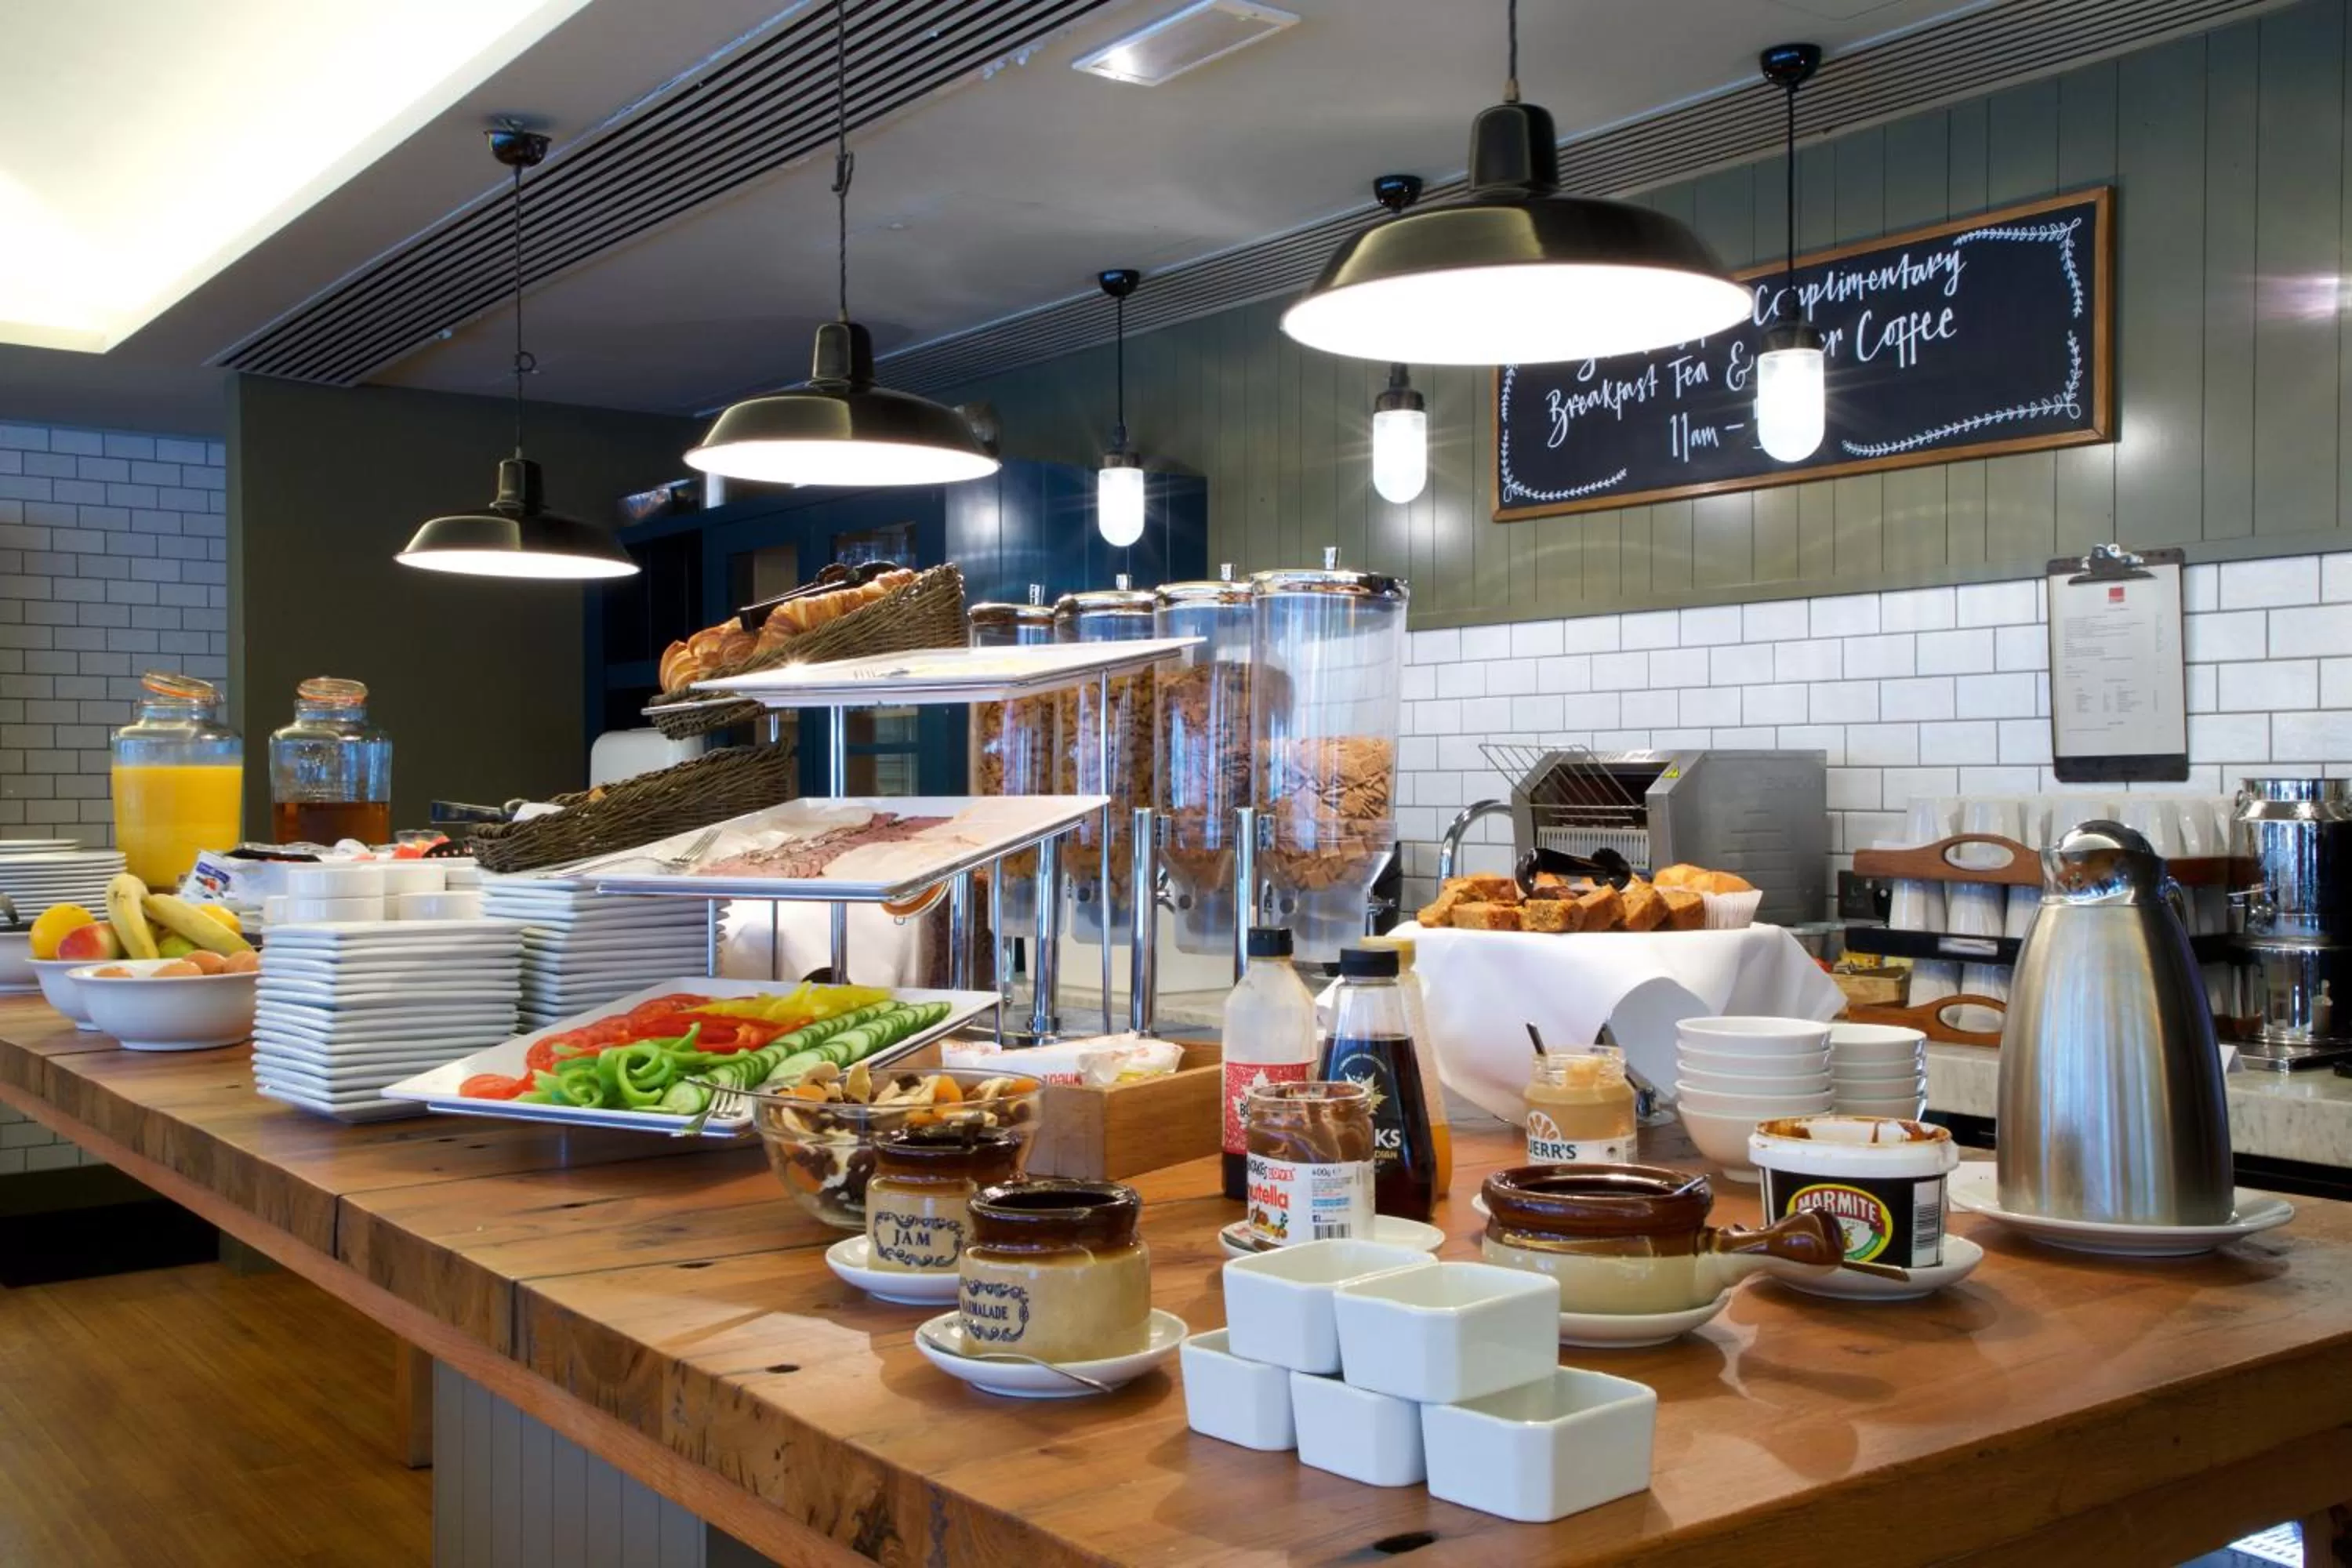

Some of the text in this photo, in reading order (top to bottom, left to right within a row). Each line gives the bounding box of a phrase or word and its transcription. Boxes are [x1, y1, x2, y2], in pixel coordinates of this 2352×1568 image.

[1546, 364, 1658, 448] Breakfast
[1668, 356, 1708, 399] Tea
[1726, 341, 1754, 390] &
[1857, 307, 1957, 368] Coffee
[1670, 412, 1719, 462] 11am
[1248, 1183, 1289, 1209] utella
[1798, 1190, 1878, 1222] MARMITE
[894, 1229, 931, 1247] JAM
